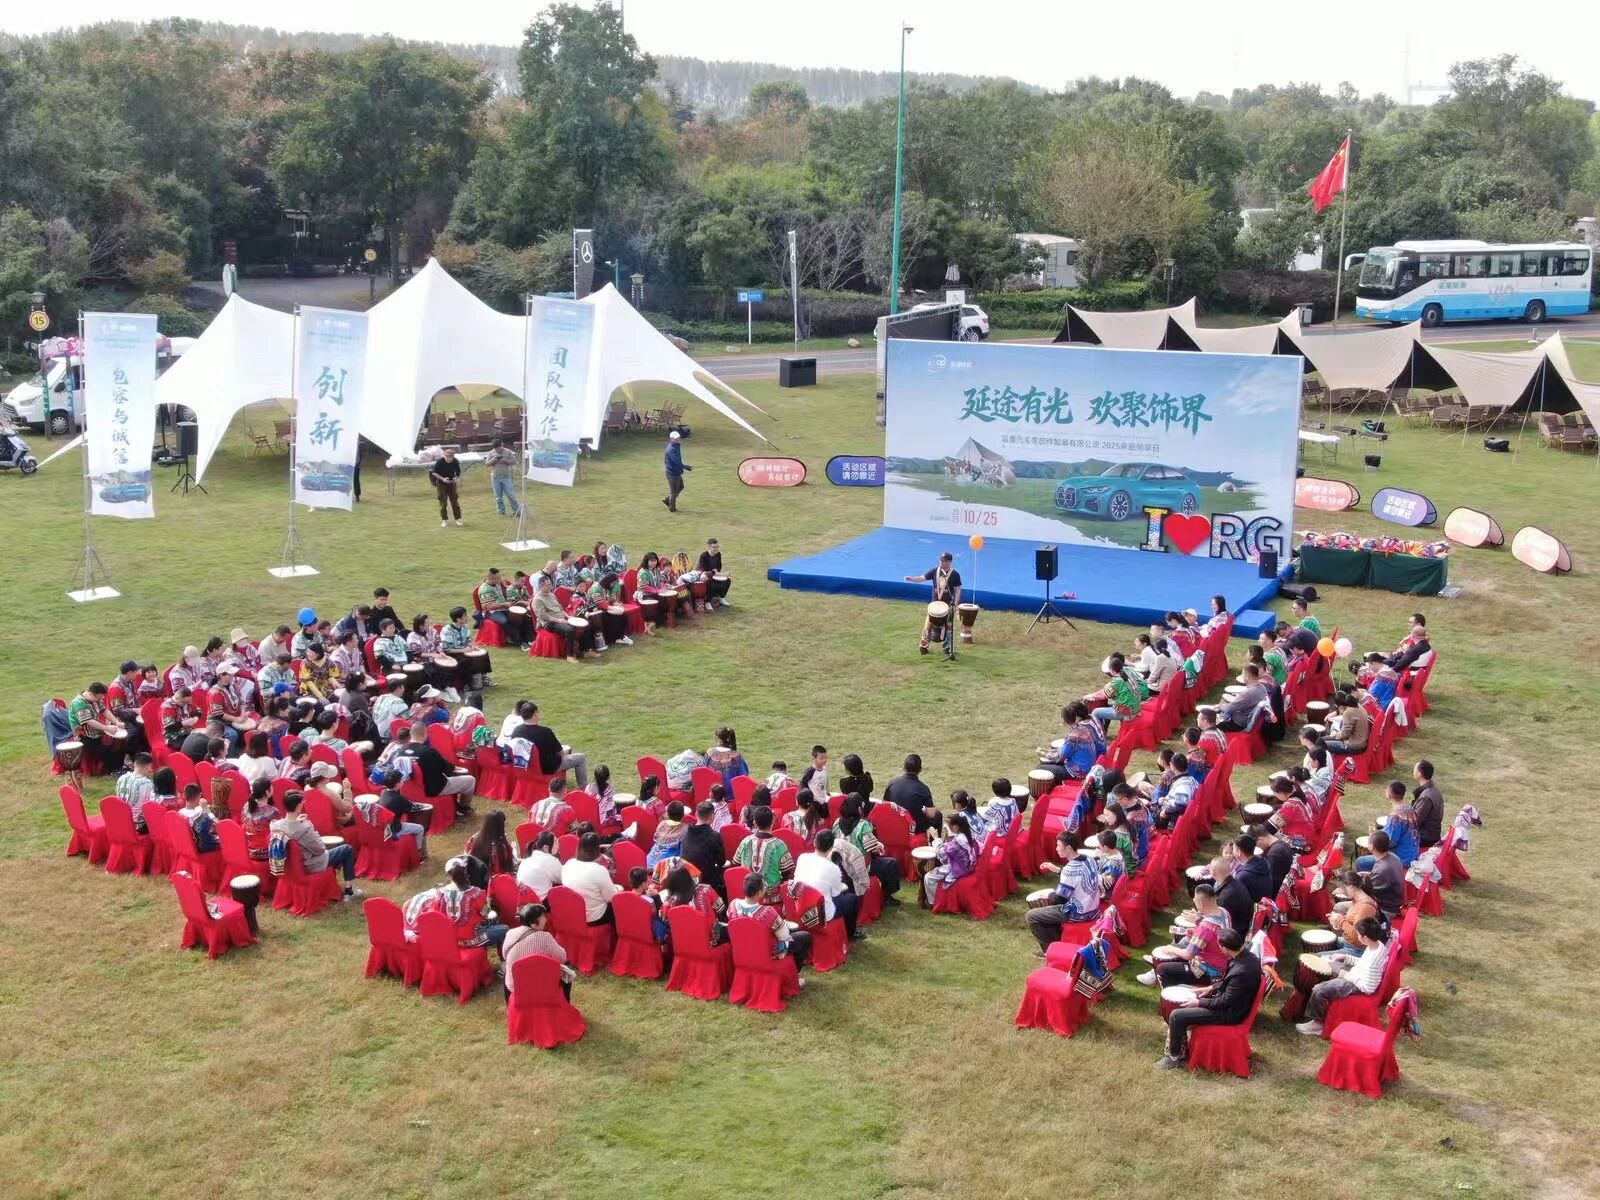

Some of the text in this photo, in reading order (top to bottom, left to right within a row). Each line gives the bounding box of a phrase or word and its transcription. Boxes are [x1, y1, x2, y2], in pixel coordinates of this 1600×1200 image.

[34, 316, 45, 325] 15
[112, 367, 130, 465] 包容与诚信
[310, 366, 348, 451] 创新
[540, 347, 568, 437] 团队协作
[958, 384, 1213, 438] 延途有光 欢聚饰界
[842, 462, 877, 471] 活动区域
[842, 471, 876, 481] 请勿靠近
[964, 510, 998, 526] 10/25
[1140, 505, 1284, 564] I RG
